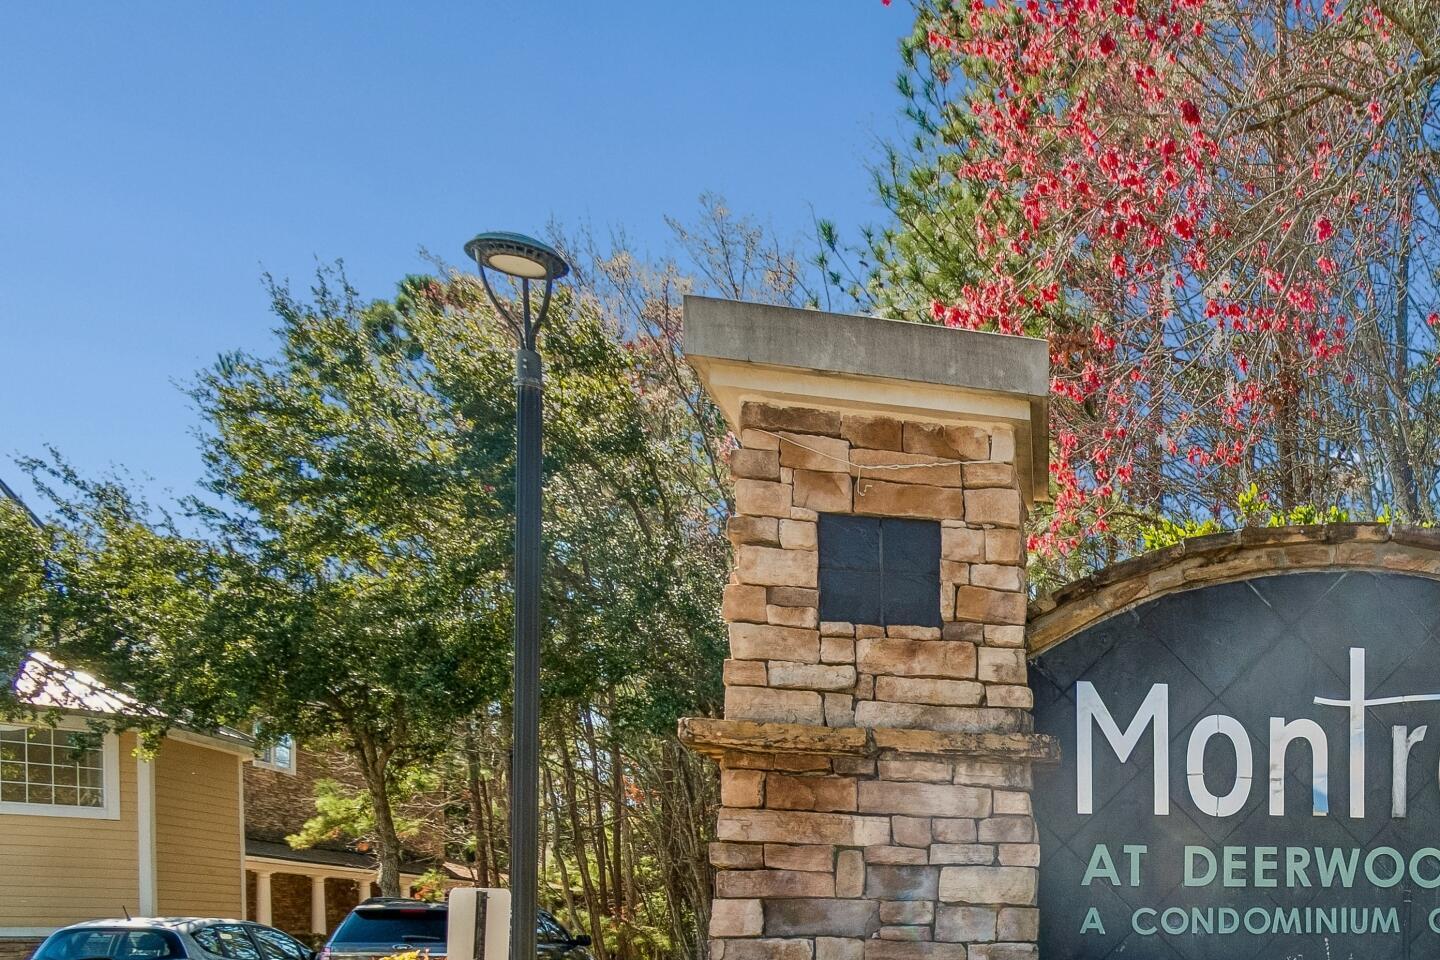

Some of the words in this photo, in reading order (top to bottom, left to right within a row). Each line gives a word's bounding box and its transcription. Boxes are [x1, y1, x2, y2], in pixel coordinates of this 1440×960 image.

[1080, 844, 1148, 887] AT
[1079, 909, 1106, 935] A
[1131, 907, 1400, 935] CONDOMINIUM
